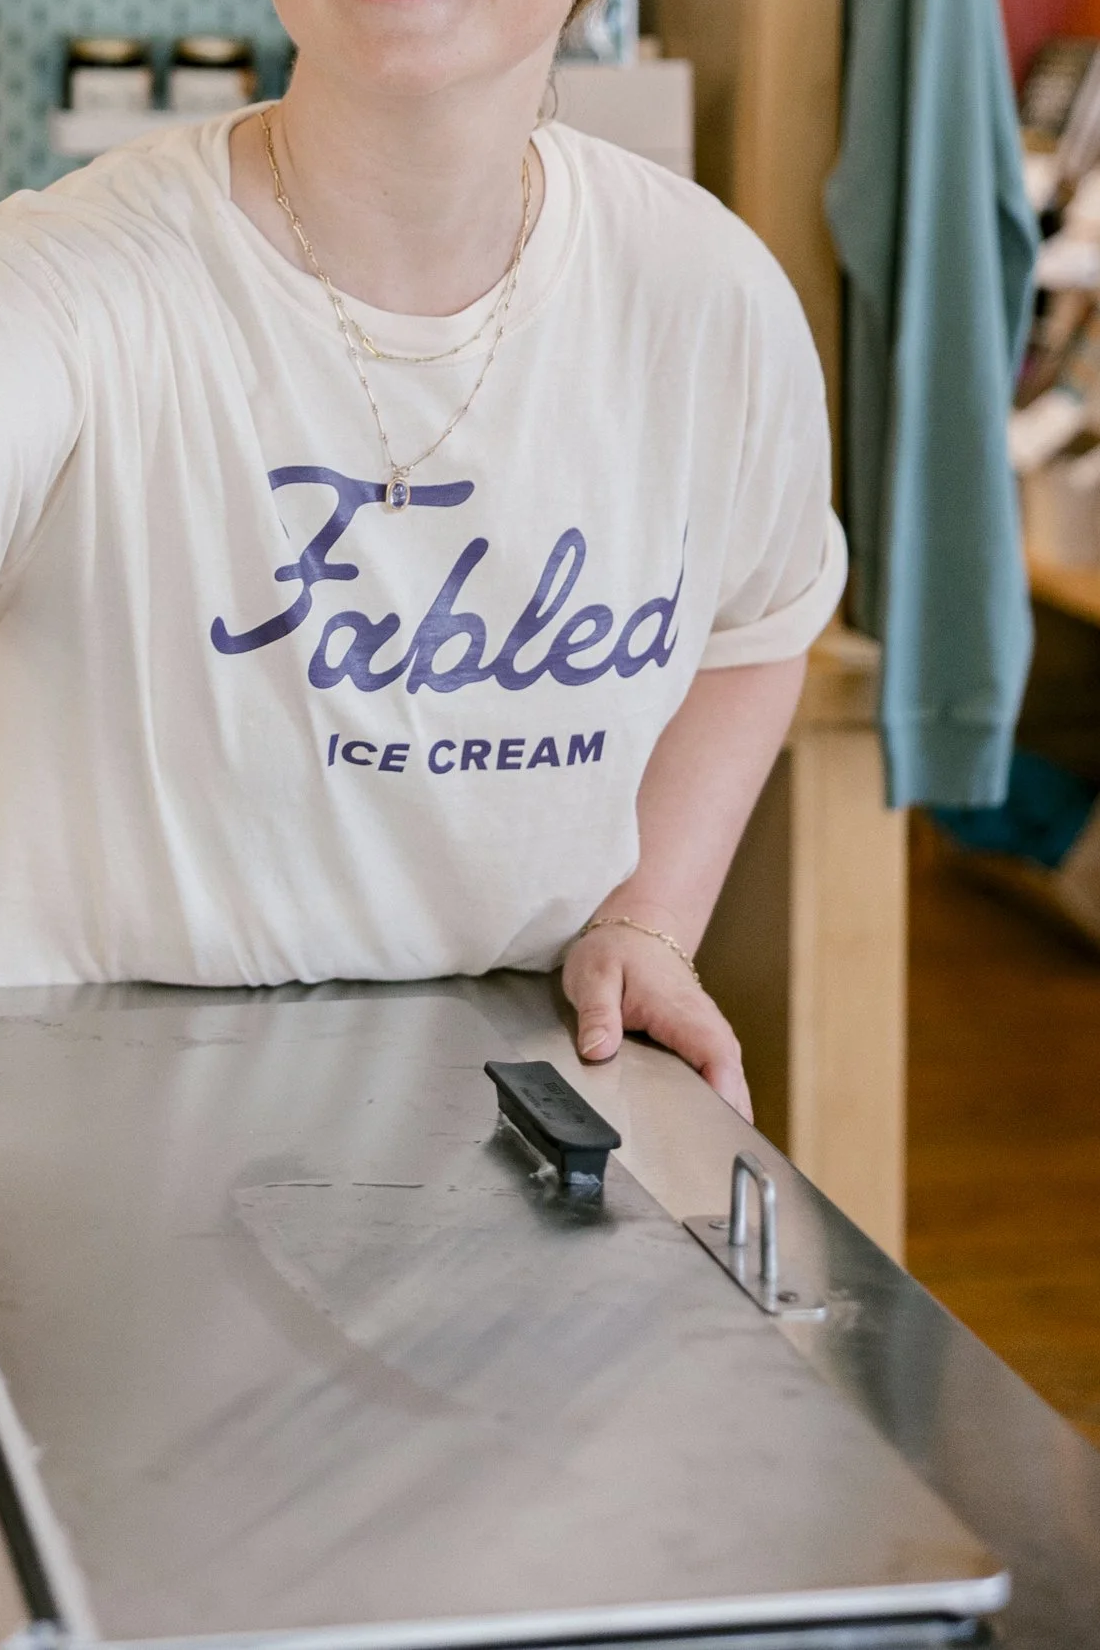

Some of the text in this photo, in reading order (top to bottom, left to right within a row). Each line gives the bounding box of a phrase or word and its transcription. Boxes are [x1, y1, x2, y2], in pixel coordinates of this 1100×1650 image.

[211, 465, 689, 695] Fabled
[327, 730, 606, 774] ICE CREAM
